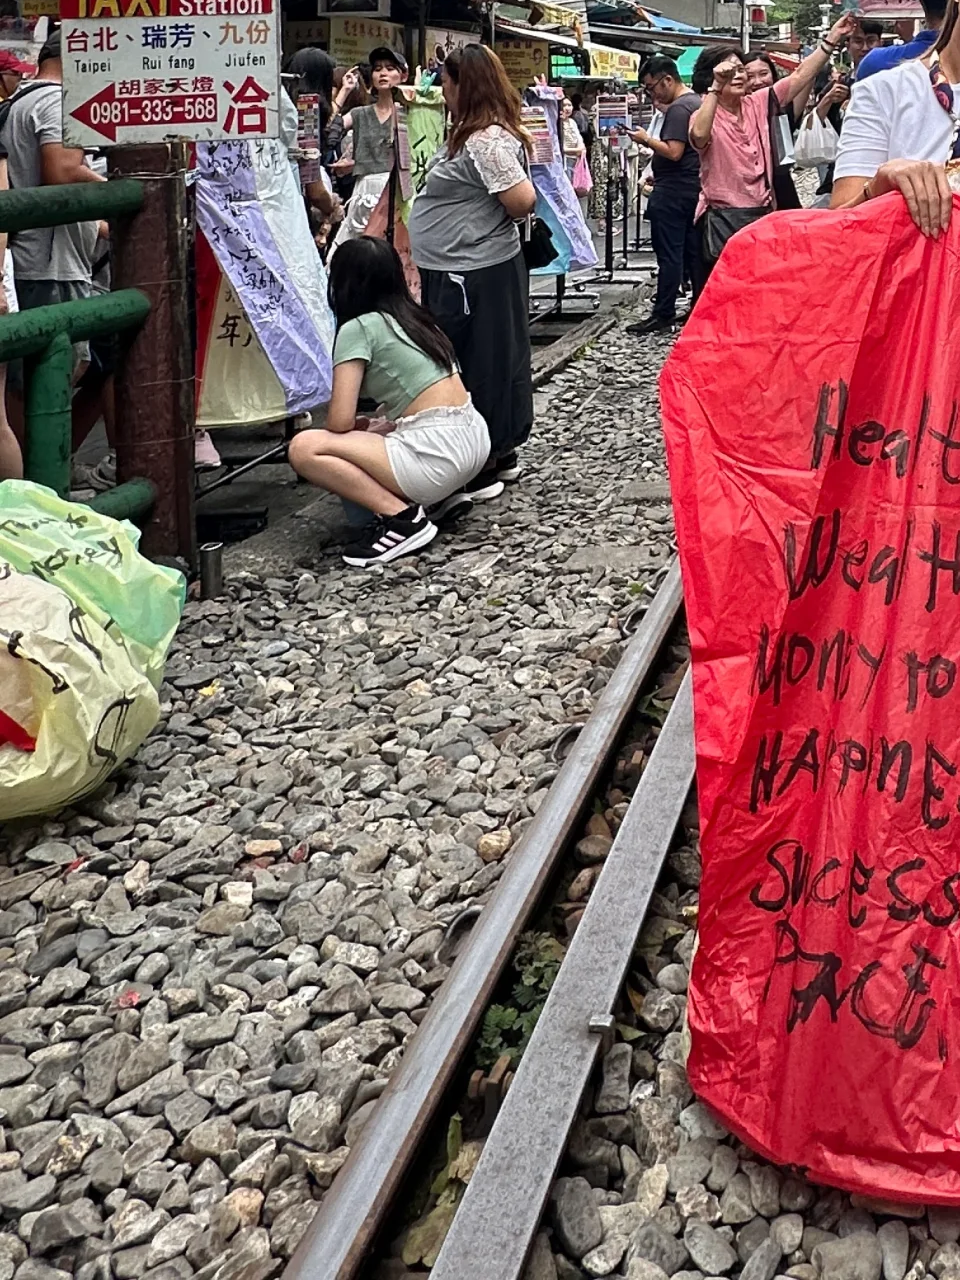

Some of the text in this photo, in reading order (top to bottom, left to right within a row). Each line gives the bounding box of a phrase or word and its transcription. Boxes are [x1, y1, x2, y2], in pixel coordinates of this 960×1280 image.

[74, 58, 111, 74] Taipei
[225, 52, 266, 67] Jiufen
[118, 76, 215, 96] 胡家天燈
[90, 96, 216, 125] 0981-333-568
